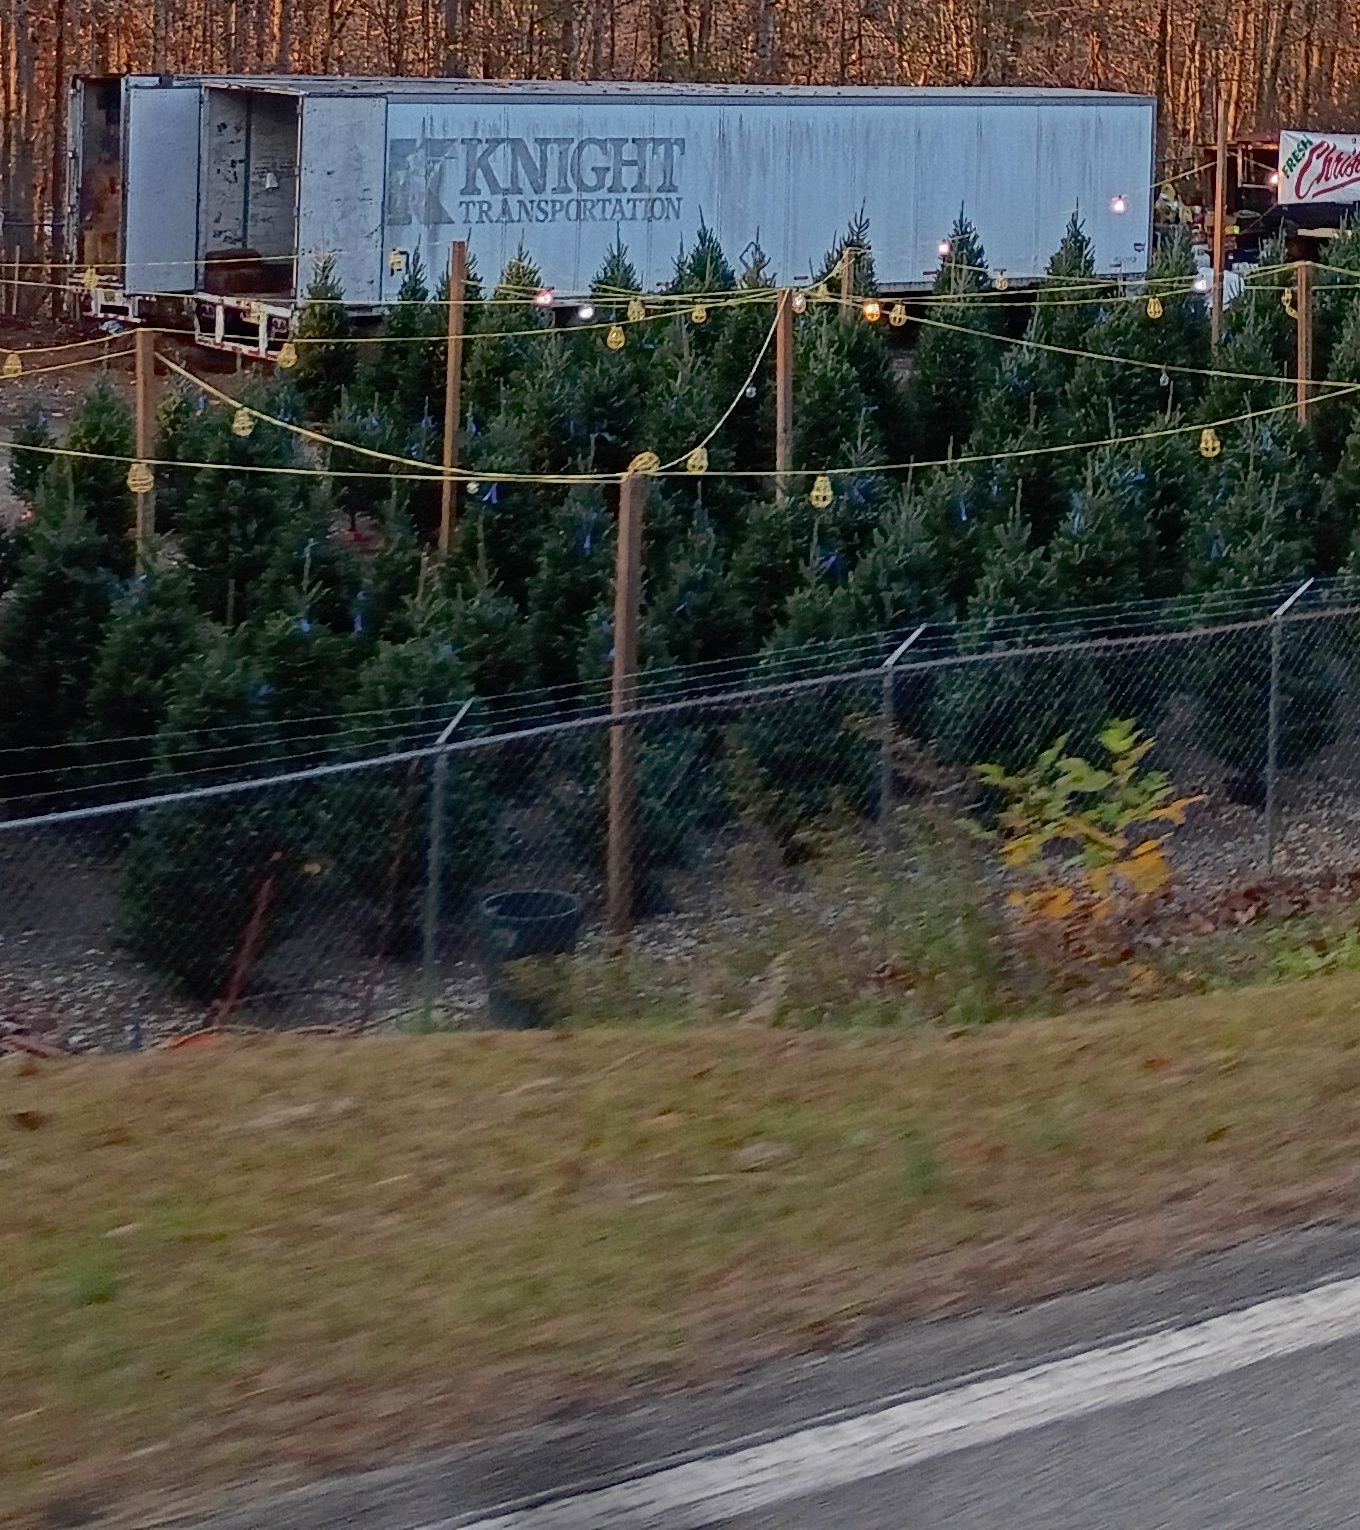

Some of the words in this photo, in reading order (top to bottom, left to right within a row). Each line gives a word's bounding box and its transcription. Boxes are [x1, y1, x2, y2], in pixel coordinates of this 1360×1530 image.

[459, 137, 686, 196] KNIGHT
[1281, 134, 1314, 179] FRESH
[458, 196, 684, 225] TRANSPORTATION
